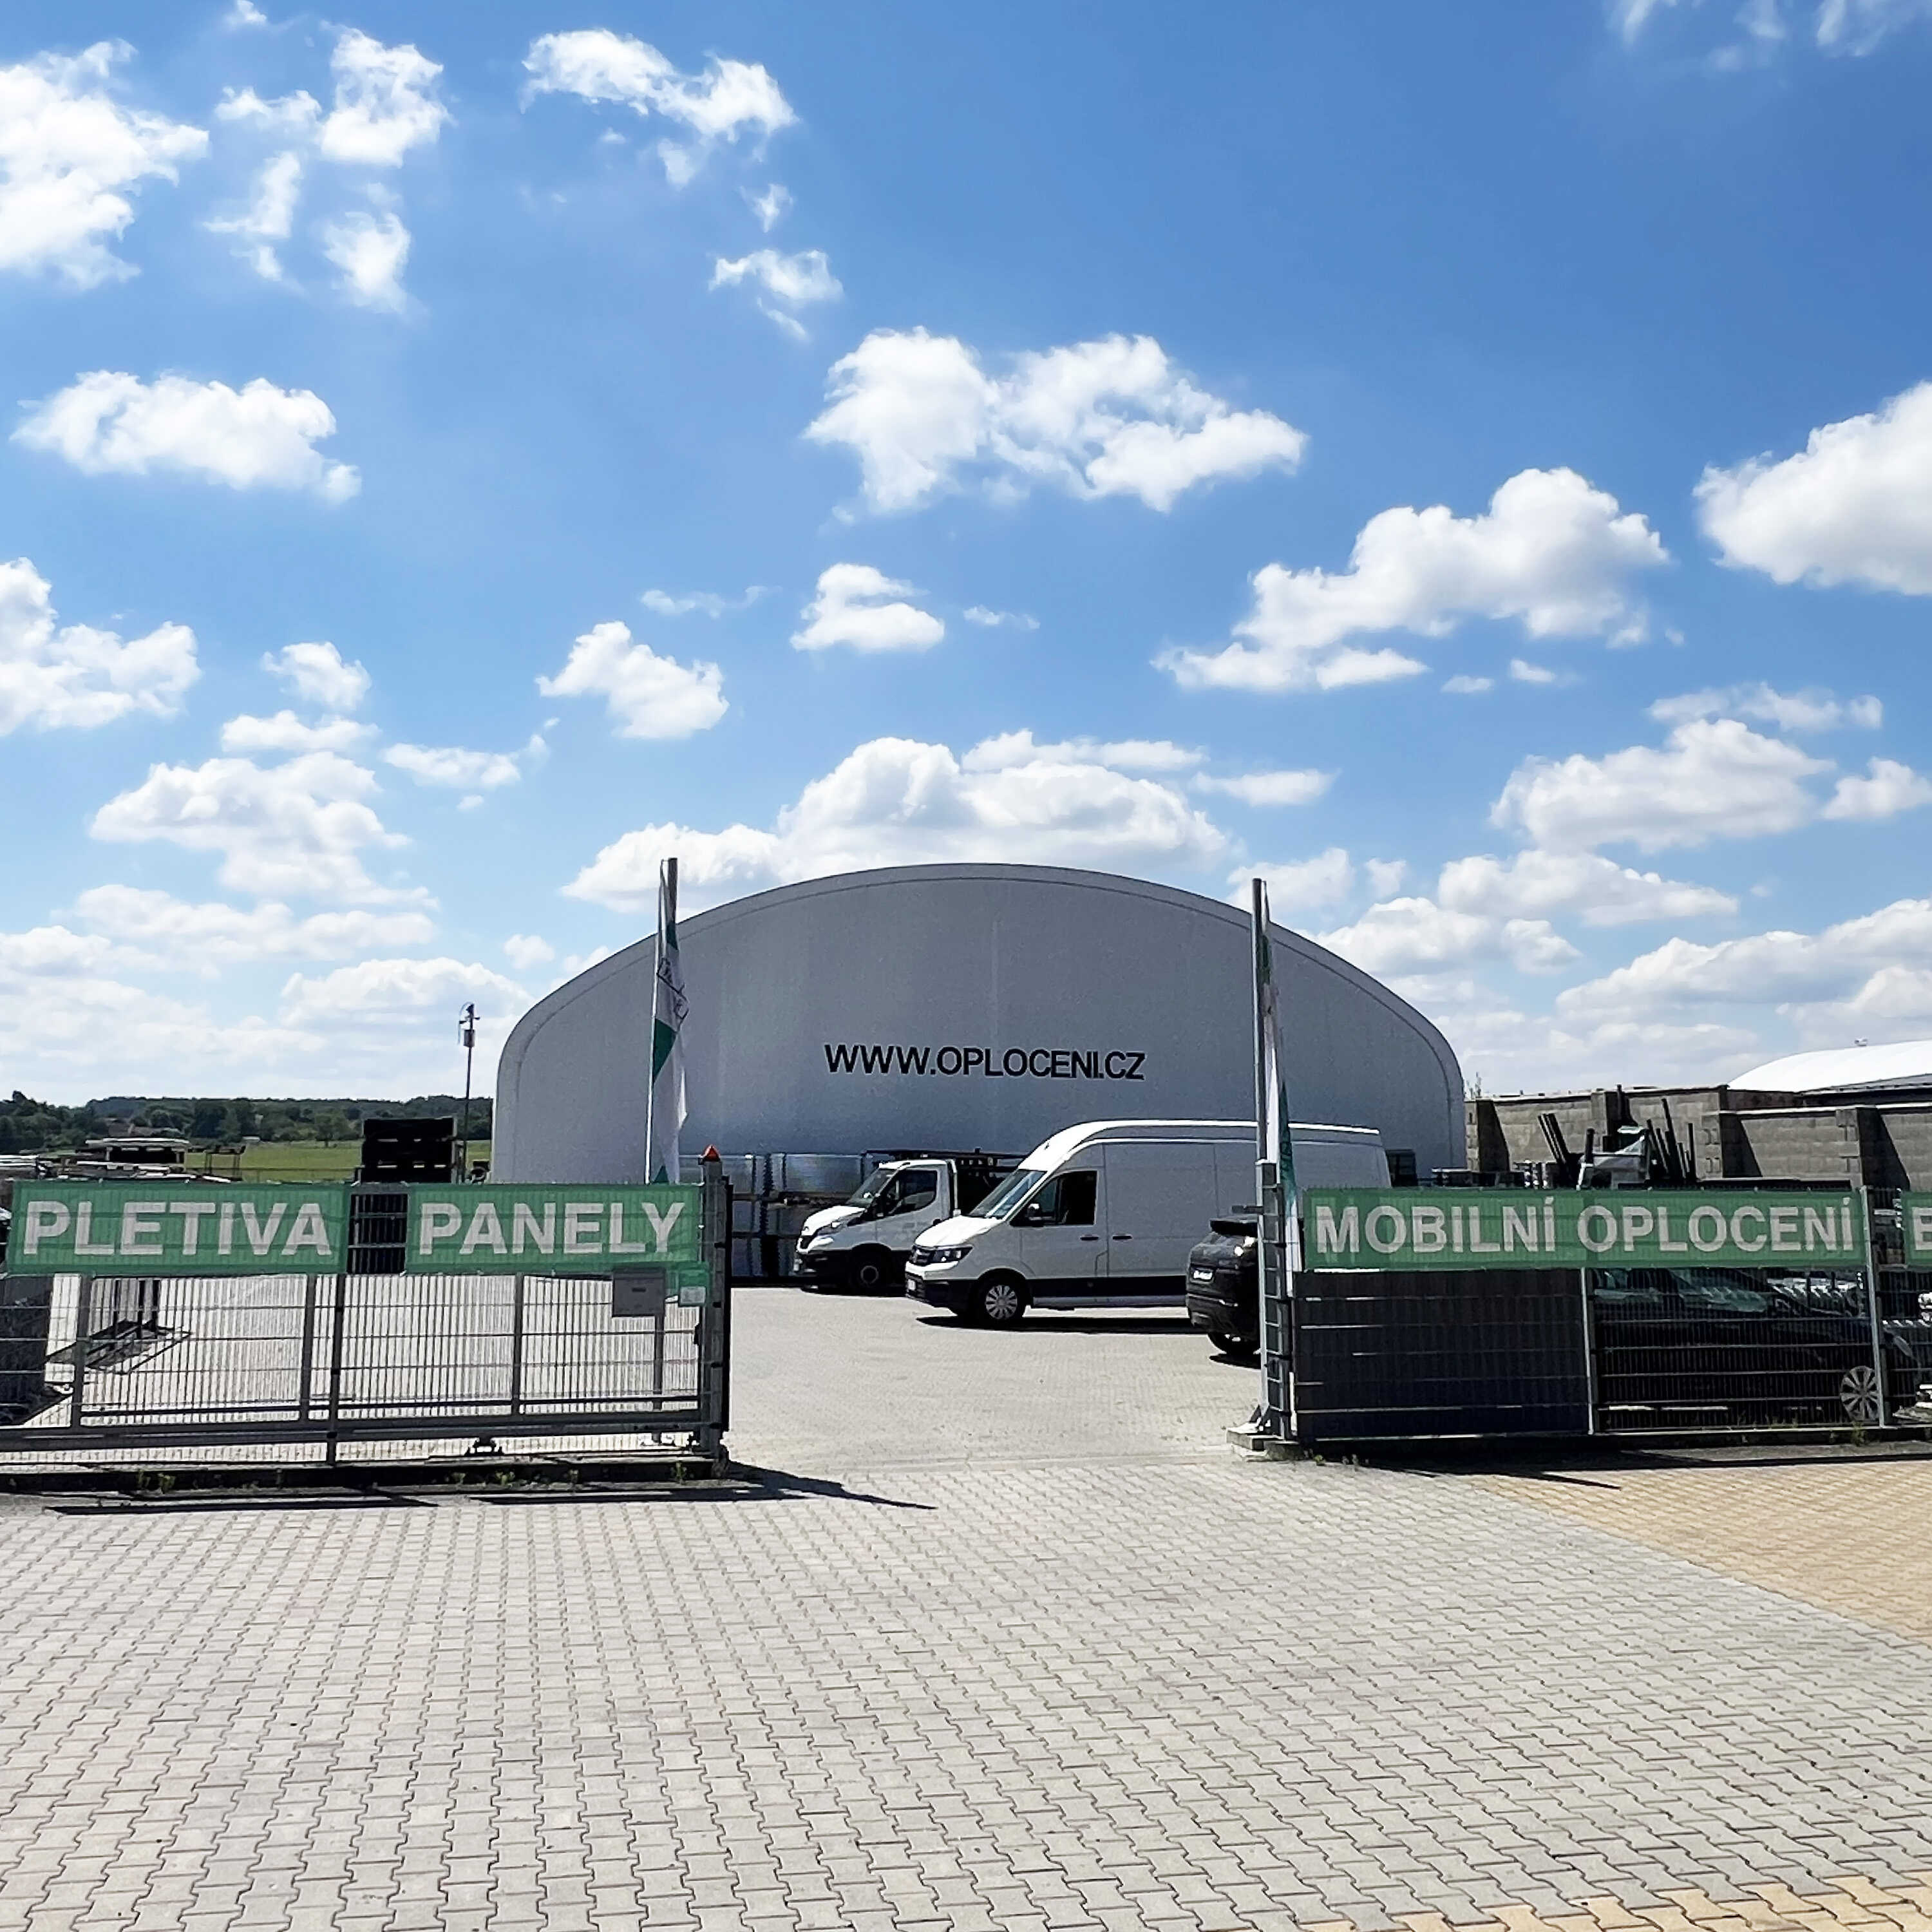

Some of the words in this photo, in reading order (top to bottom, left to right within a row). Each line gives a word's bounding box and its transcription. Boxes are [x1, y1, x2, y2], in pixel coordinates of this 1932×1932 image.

[824, 1044, 1146, 1080] WWW.OPLOCENI.CZ
[23, 1200, 332, 1255] PLETIVA
[419, 1202, 686, 1255] PANELY
[1316, 1197, 1556, 1253] MOBILNÍ
[1577, 1197, 1854, 1253] OPLOCENÍ
